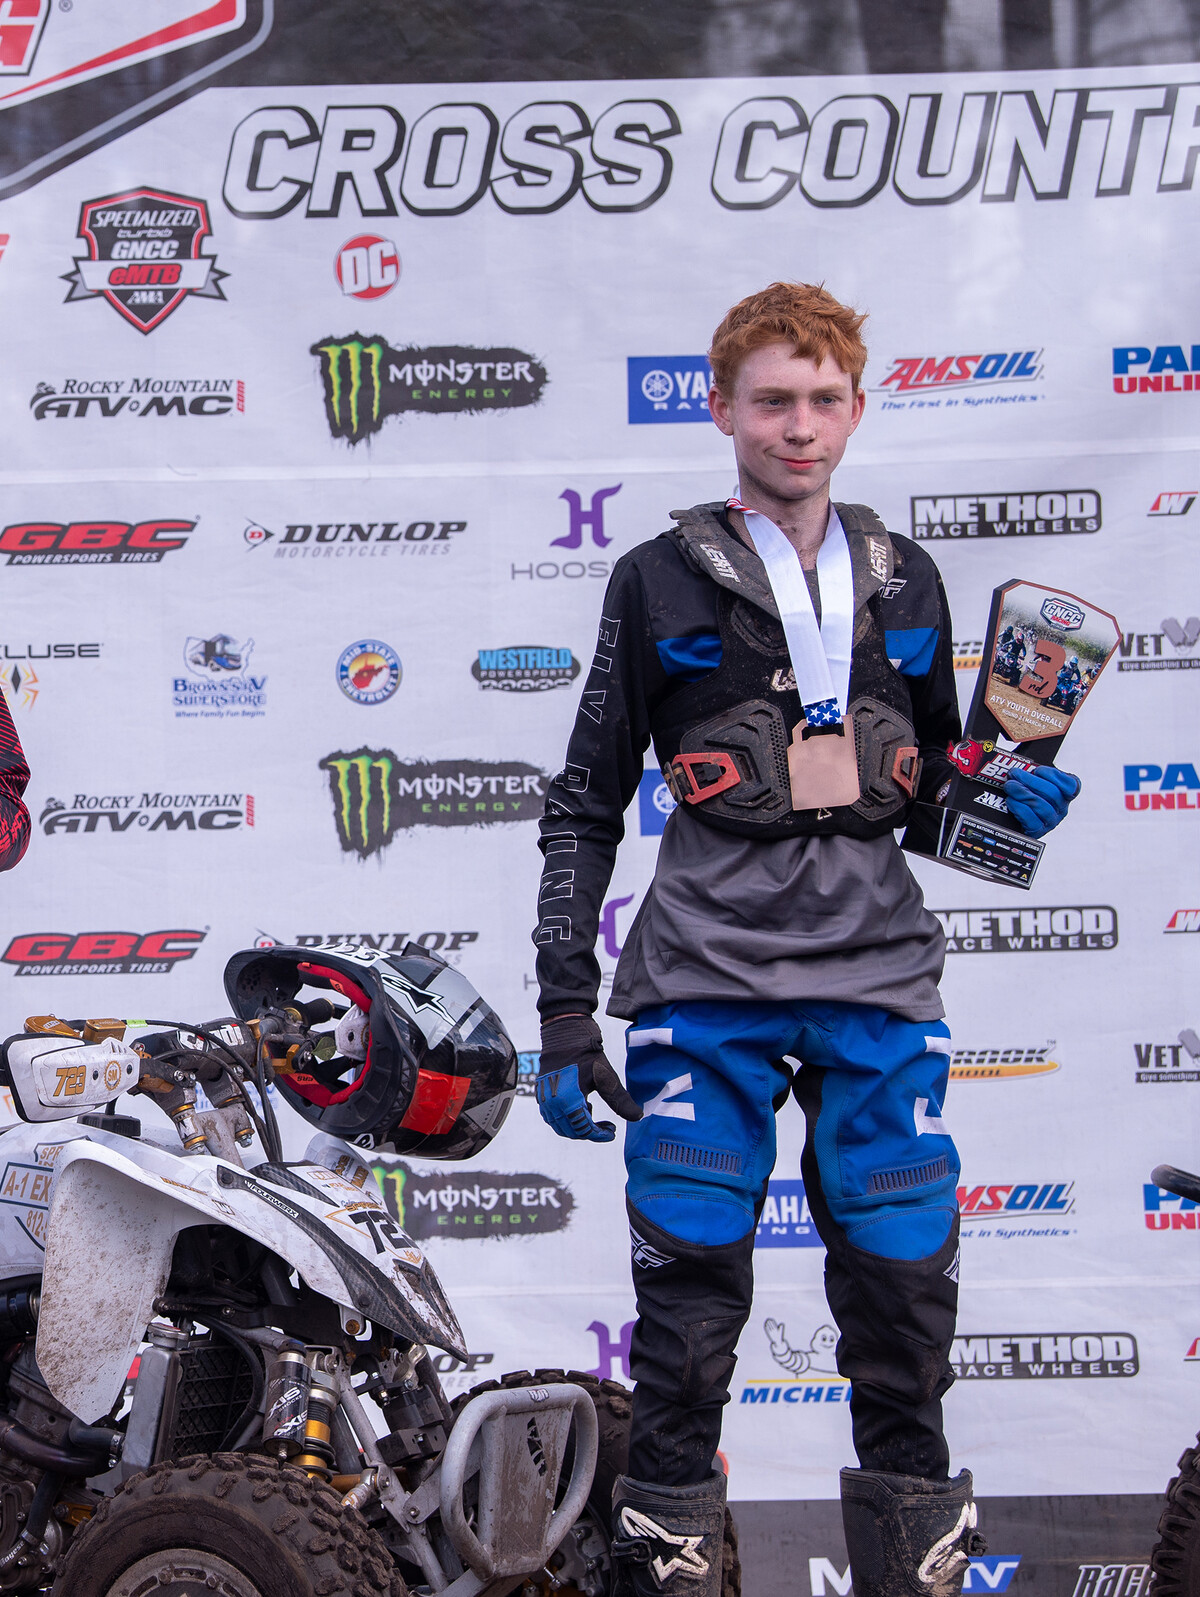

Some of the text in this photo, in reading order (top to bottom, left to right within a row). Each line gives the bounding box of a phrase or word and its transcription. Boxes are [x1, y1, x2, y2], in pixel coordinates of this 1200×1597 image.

[222, 99, 681, 218] CROSS
[92, 209, 197, 227] SPECIALIZED
[111, 240, 179, 260] GNCC
[108, 264, 181, 286] eMTB
[340, 240, 398, 295] DC
[389, 358, 535, 385] MONSTER
[881, 348, 1044, 391] AMSOIL
[63, 378, 234, 393] ROCKY MOUNTAIN
[412, 388, 512, 400] ENERGY
[881, 401, 906, 411] The
[909, 399, 941, 409] First
[964, 395, 1038, 407] Synthetics
[913, 492, 1097, 525] METHOD
[279, 521, 467, 544] DUNLOP
[916, 518, 1098, 537] RACE WHEELS
[13, 552, 160, 564] POWERSPORTS TIRES
[274, 544, 452, 558] MOTORCYCLE TIRES
[1045, 603, 1081, 624] GNCC
[479, 649, 573, 669] WESTFIELD
[1019, 640, 1066, 698] 3
[480, 669, 573, 678] POWERSPORTS
[990, 694, 1063, 728] ATV YOUTH OVERALL
[399, 772, 544, 799] MONSTER
[72, 793, 243, 809] ROCKY MOUNTAIN
[422, 802, 521, 813] ENERGY
[5, 931, 202, 961] GBC
[1008, 935, 1114, 949] WHEELS
[22, 962, 168, 975] POWERSPORTS TIRES
[1134, 1044, 1183, 1068] VET
[53, 1065, 87, 1098] 723
[107, 1070, 119, 1082] SM
[413, 1184, 562, 1212] MONSTER
[437, 1214, 539, 1225] ENERGY
[978, 1229, 991, 1238] in
[996, 1228, 1070, 1239] Synthetics
[948, 1336, 1134, 1363] METHOD
[1030, 1362, 1135, 1374] WHEELS
